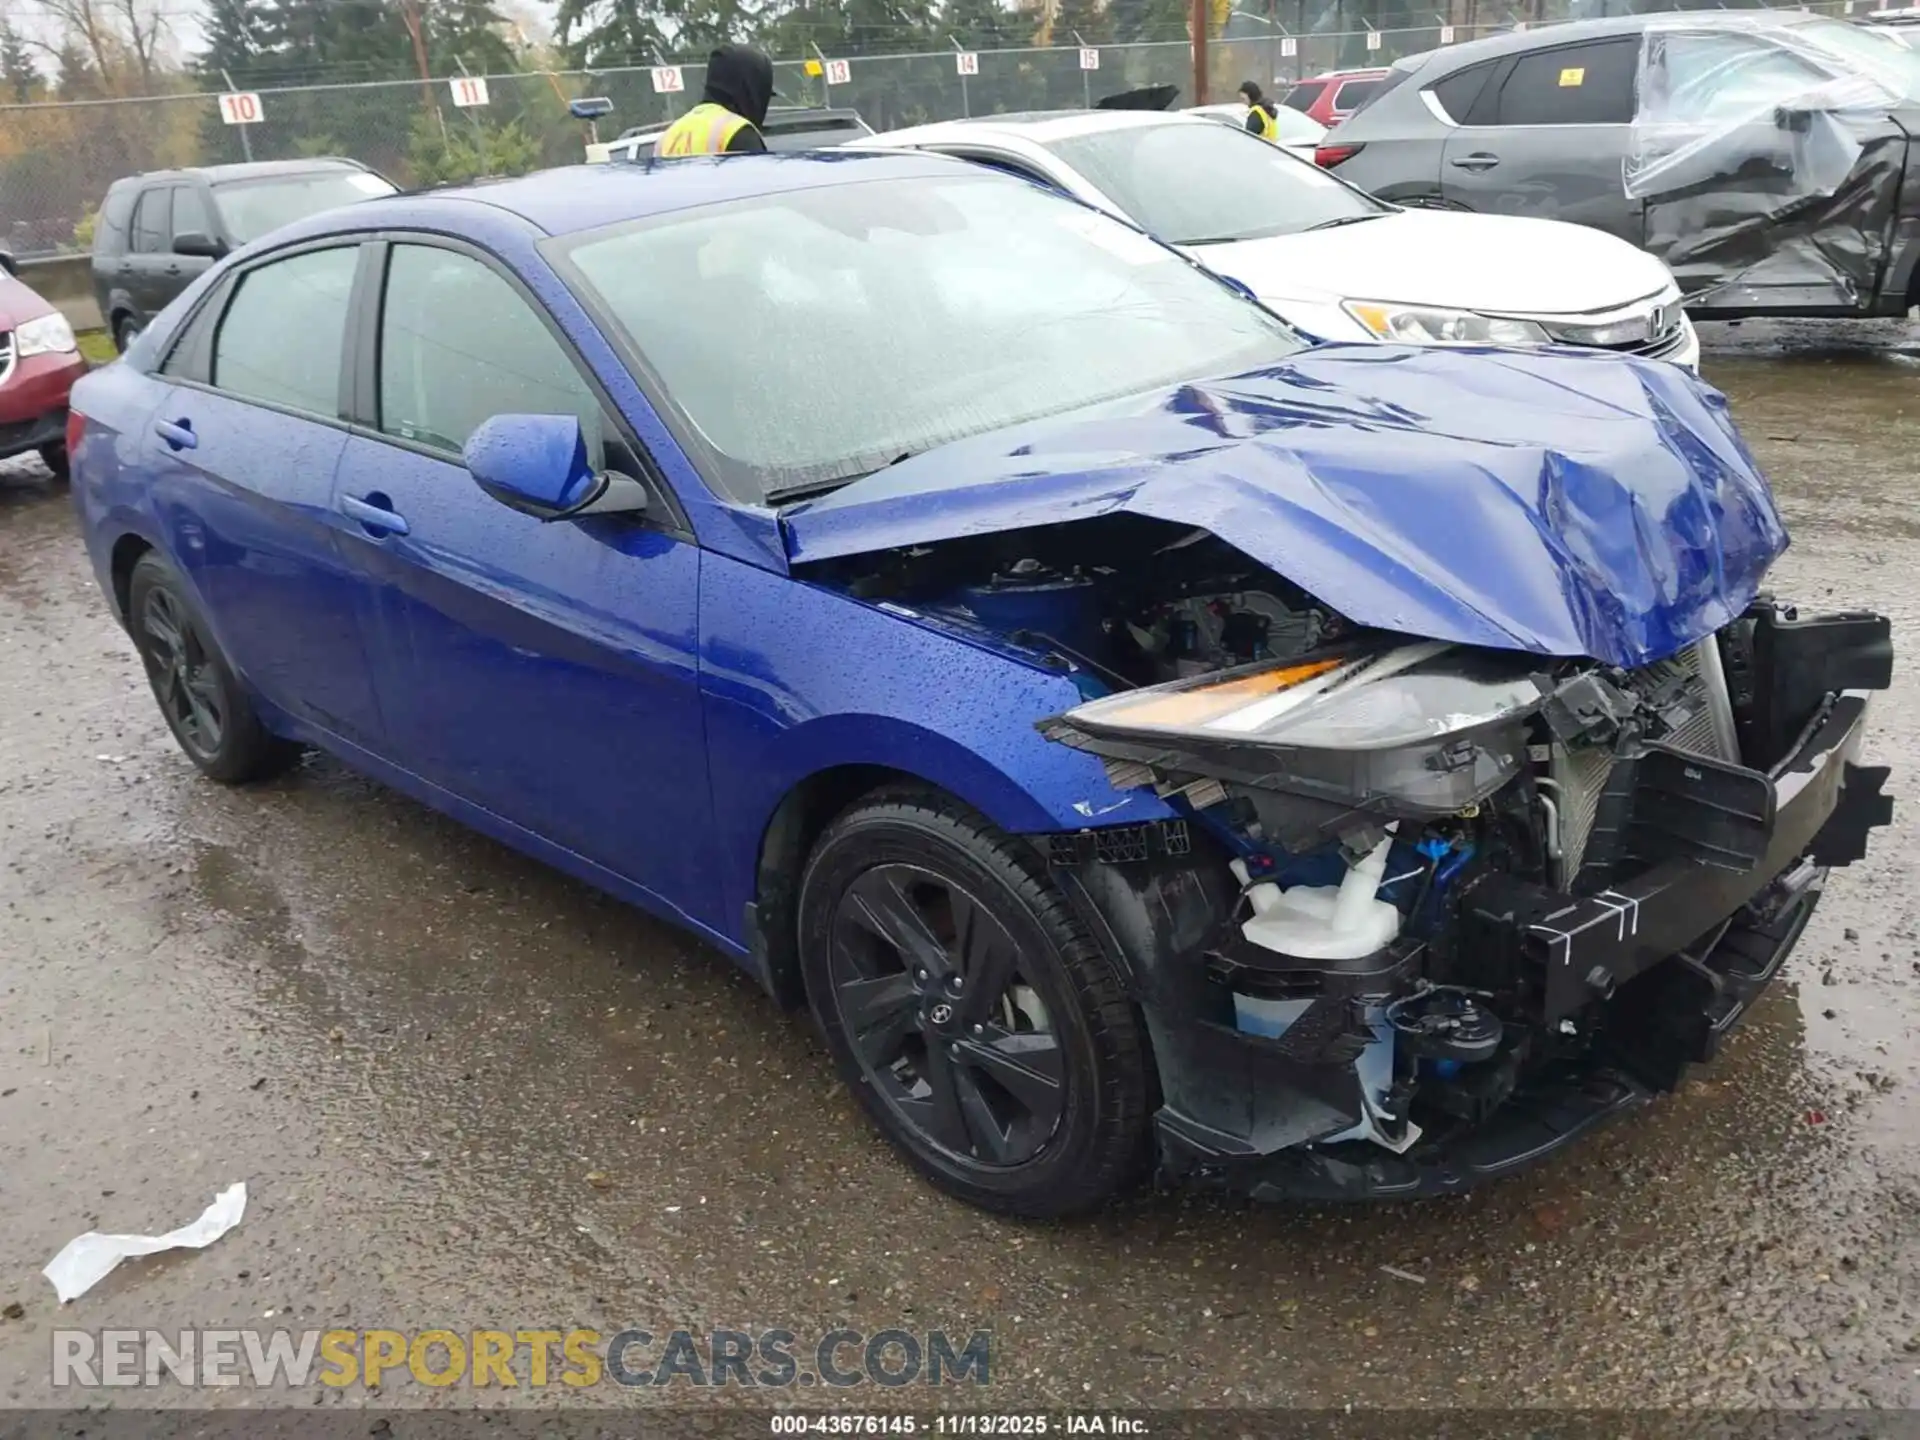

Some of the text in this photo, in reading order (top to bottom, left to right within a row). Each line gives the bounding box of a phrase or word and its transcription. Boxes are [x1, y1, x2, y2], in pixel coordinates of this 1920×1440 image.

[961, 55, 974, 72] 14
[1084, 51, 1096, 69] 15
[657, 69, 678, 90] 12
[830, 62, 847, 82] 13
[460, 79, 480, 103] 11
[227, 95, 256, 121] 10
